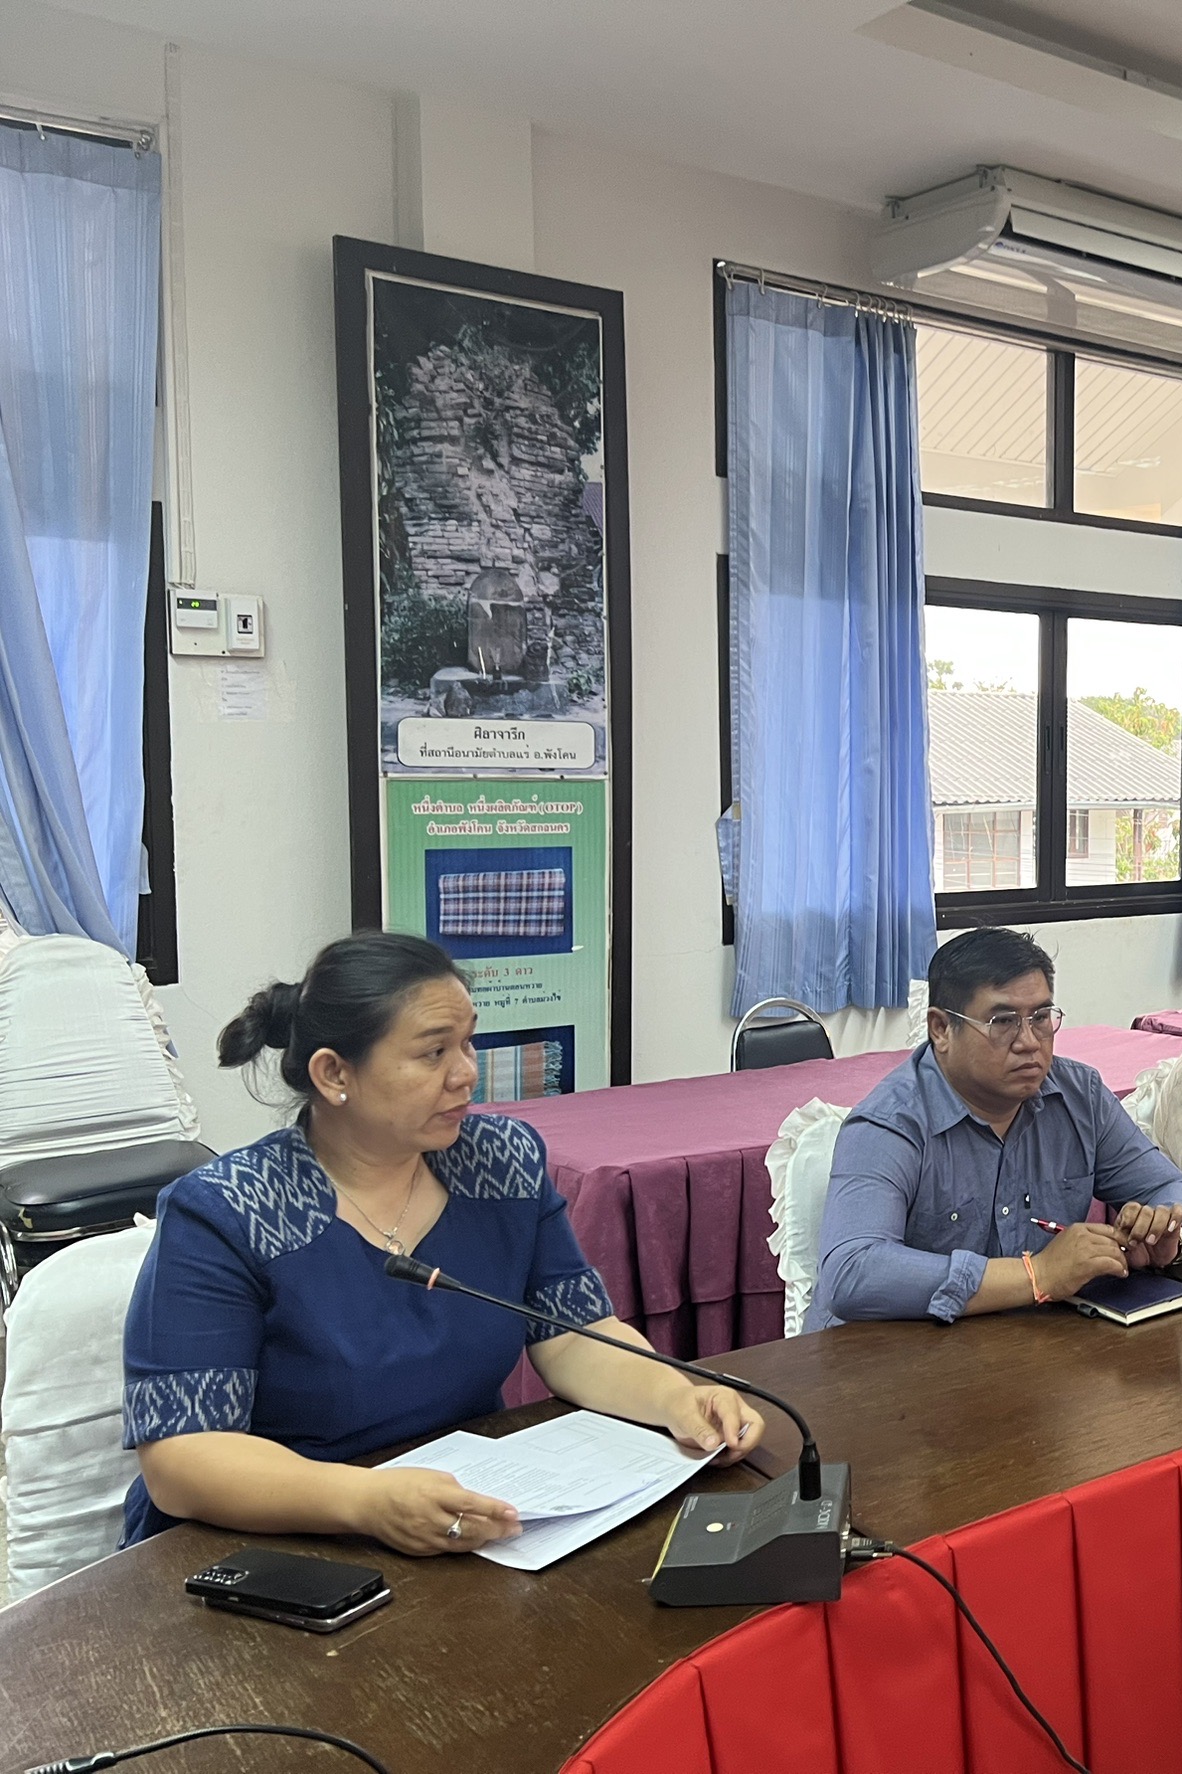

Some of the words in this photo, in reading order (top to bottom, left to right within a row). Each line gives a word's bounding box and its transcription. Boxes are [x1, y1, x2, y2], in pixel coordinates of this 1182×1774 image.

[474, 726, 525, 741] ศิลาจารึก
[412, 795, 464, 814] หนึ่งตำบล
[427, 821, 492, 835] อำเภอพังโคน
[496, 820, 570, 834] จังหวัดสกลนคร
[504, 967, 510, 977] 3
[515, 966, 533, 976] ดาว
